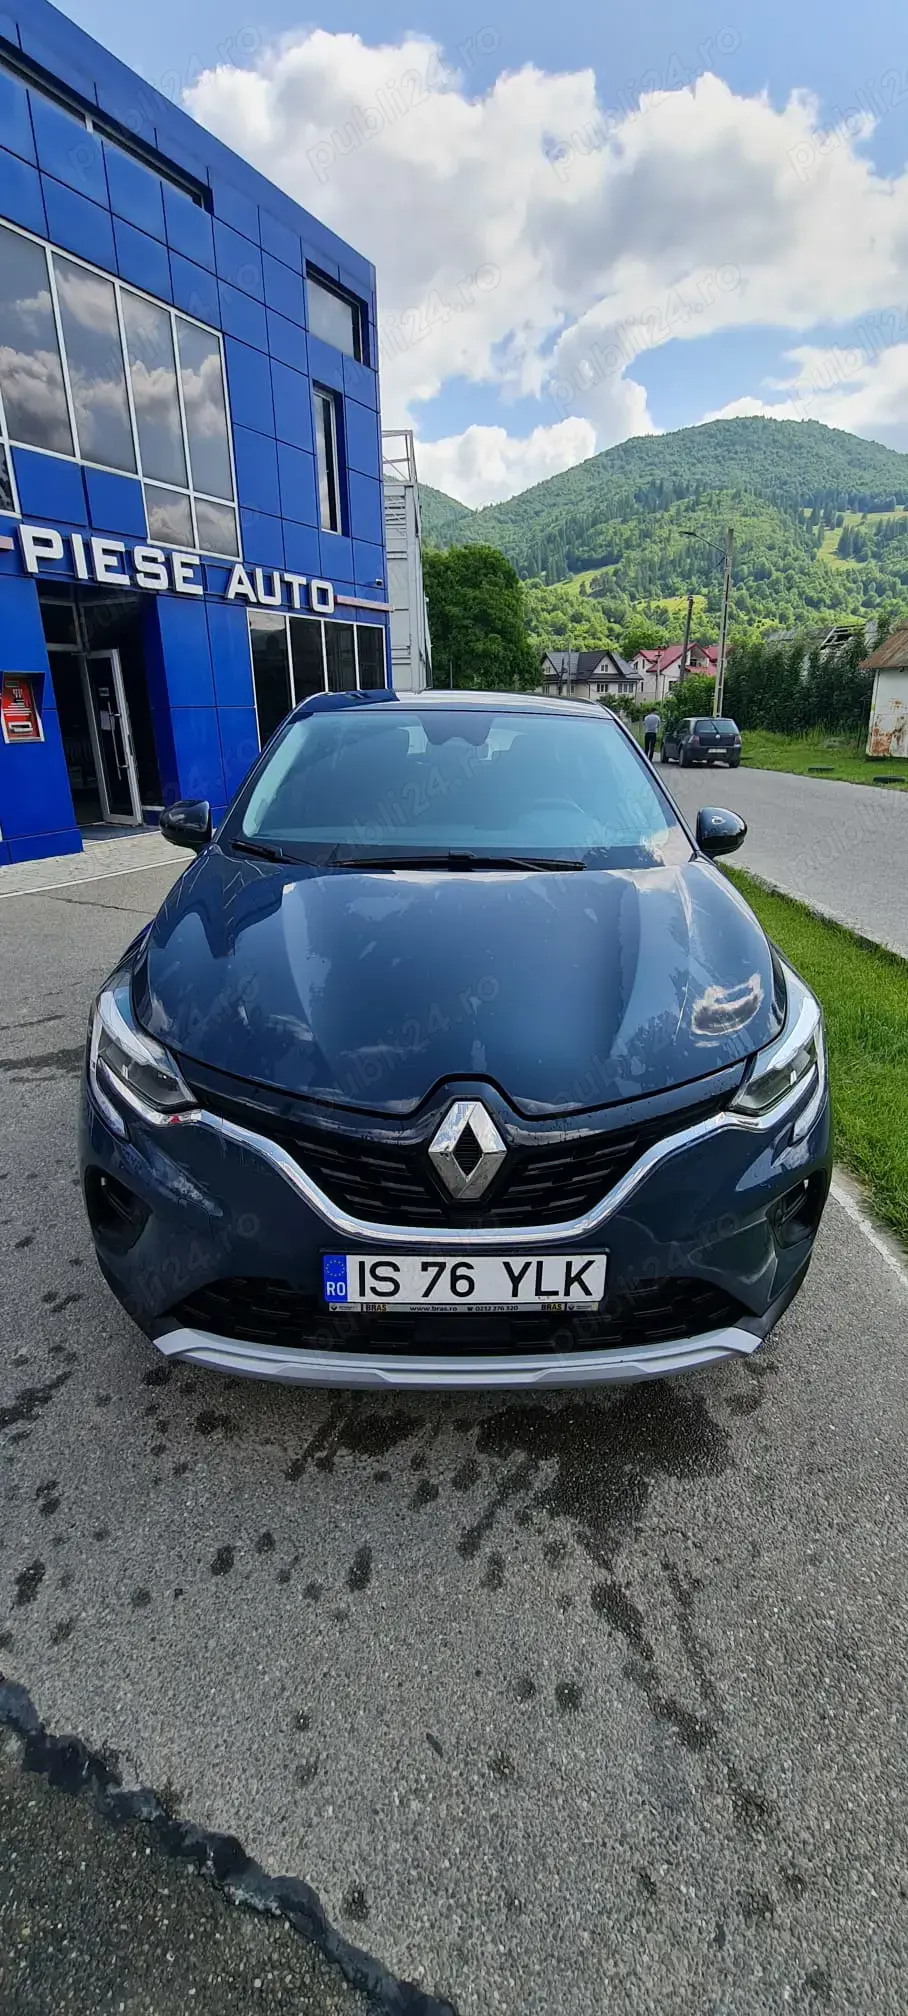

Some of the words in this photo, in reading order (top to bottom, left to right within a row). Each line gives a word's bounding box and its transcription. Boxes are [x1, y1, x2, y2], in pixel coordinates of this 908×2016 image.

[17, 524, 204, 595] PIESE
[225, 563, 335, 614] AUTO
[358, 1260, 401, 1298] IS
[420, 1261, 475, 1297] 76
[502, 1260, 595, 1297] YLK
[326, 1281, 346, 1296] RO
[365, 1303, 387, 1312] BRAS
[541, 1303, 562, 1312] BRAS
